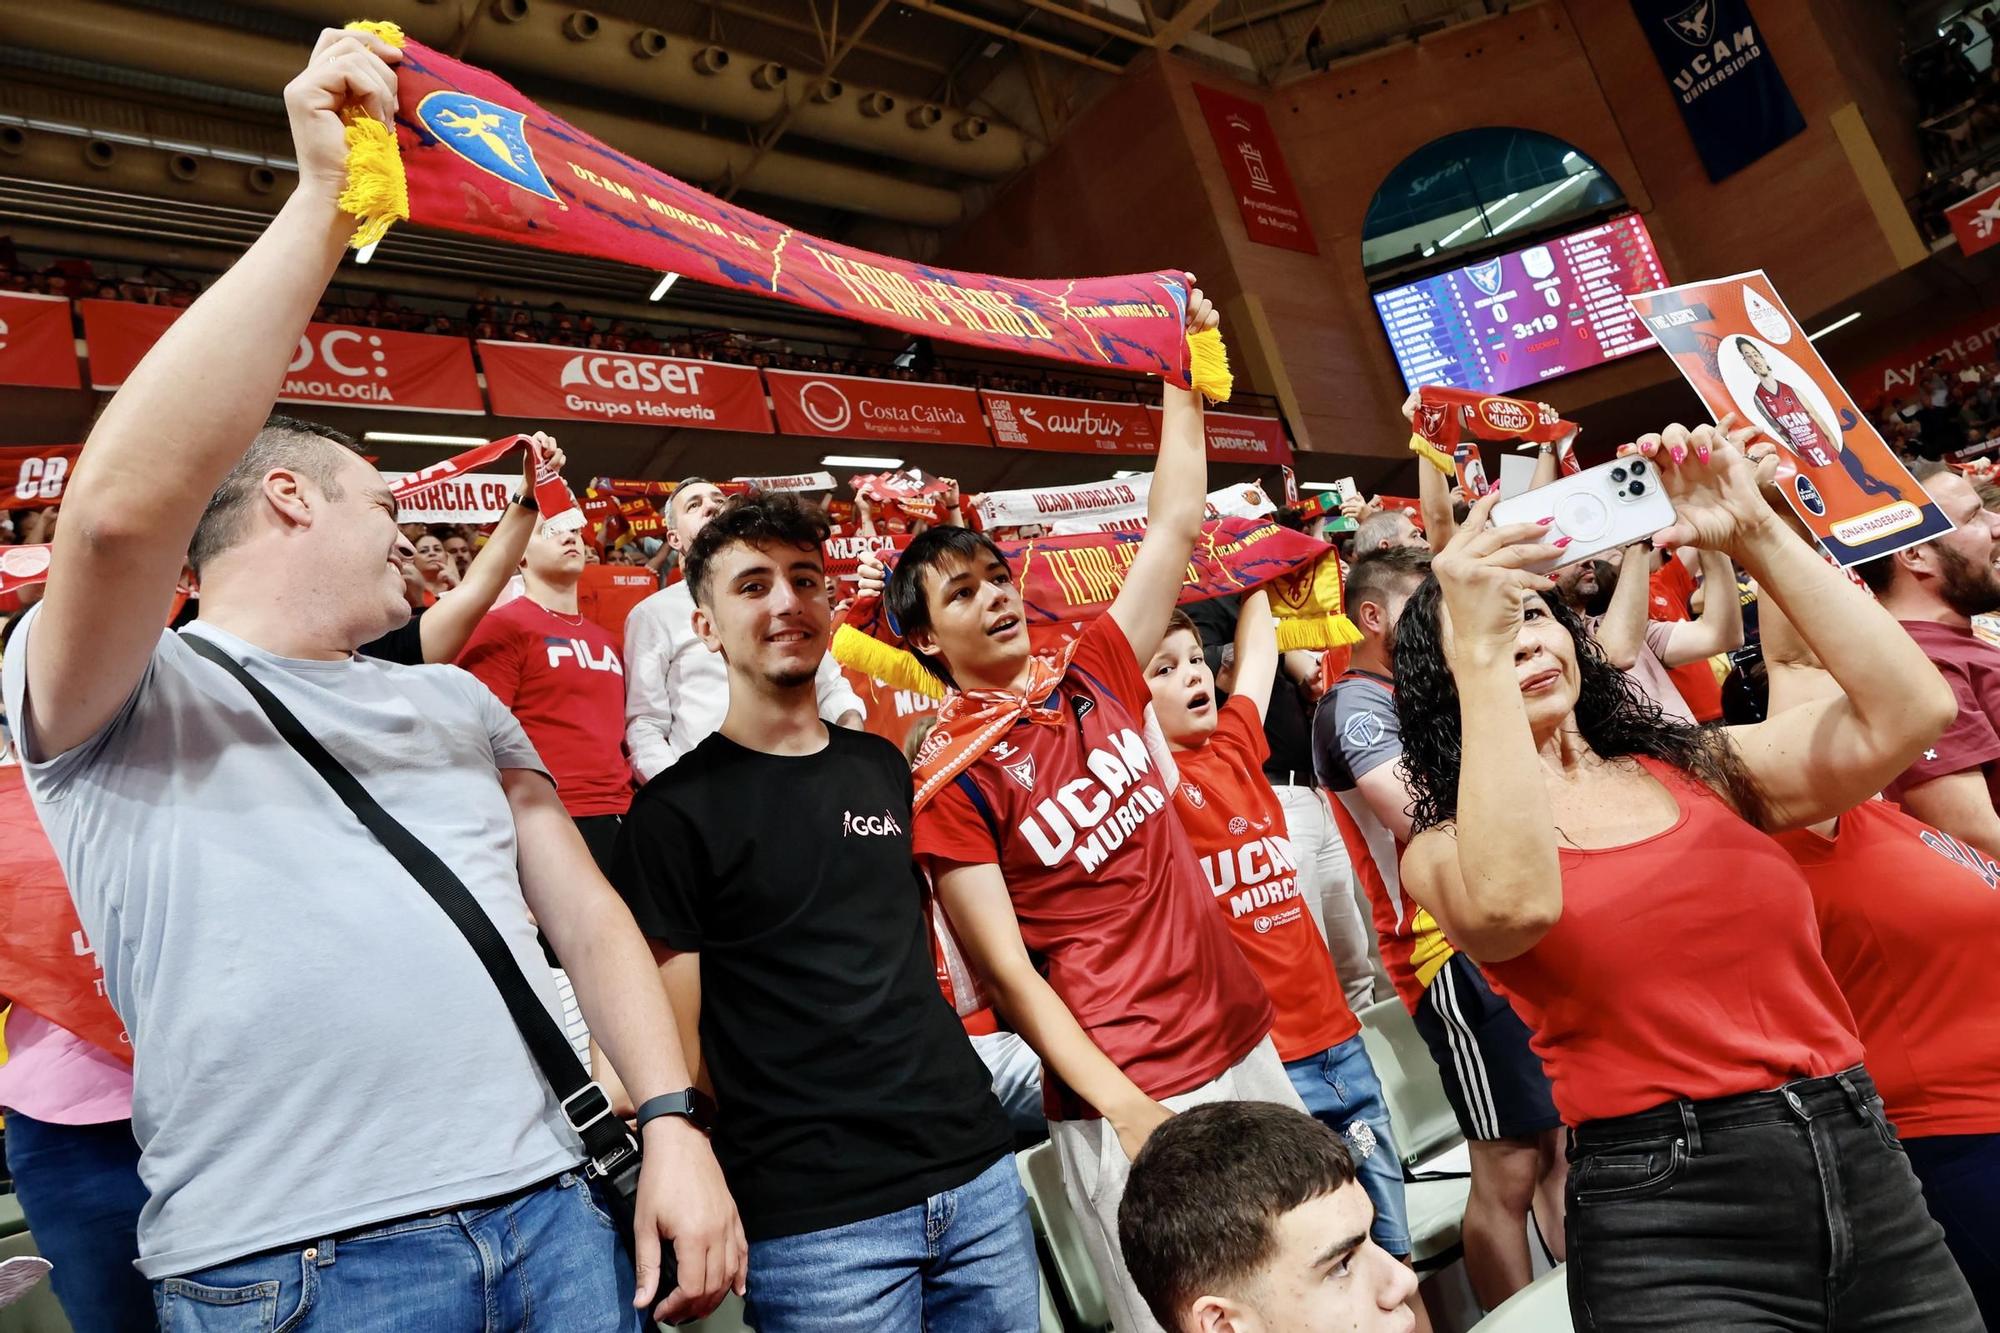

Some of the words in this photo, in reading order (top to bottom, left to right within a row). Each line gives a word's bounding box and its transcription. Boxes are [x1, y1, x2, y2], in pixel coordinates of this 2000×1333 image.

[1673, 25, 1754, 91] UCAM
[1682, 45, 1761, 104] UNIVERSIDAD
[567, 161, 637, 203] UCAM
[642, 193, 728, 239] MURCIA
[730, 230, 761, 251] CB
[1544, 287, 1560, 307] 0
[1070, 304, 1111, 319] UCAM
[1109, 303, 1154, 318] MURCIA
[1153, 303, 1170, 318] CB
[1492, 303, 1508, 323] 0
[1512, 314, 1558, 339] 3:19
[589, 357, 704, 395] caser
[281, 380, 394, 401] MOLOGÍA
[566, 394, 632, 418] Grupo
[636, 400, 716, 421] Helvetia
[859, 400, 909, 421] Costa
[911, 403, 967, 425] Cálida
[1488, 402, 1523, 417] UCAM
[1488, 412, 1528, 430] MURCIA
[1209, 436, 1268, 453] URDECON
[1808, 447, 1833, 467] 12
[15, 457, 69, 500] CB
[481, 483, 508, 511] CB
[1033, 493, 1073, 513] UCAM
[1070, 490, 1117, 510] MURCIA
[1116, 485, 1136, 504] CB
[1841, 525, 1868, 540] JONAH
[1864, 507, 1915, 532] RADEBAUGH
[826, 535, 897, 560] MURCIA
[1215, 541, 1243, 557] UCAM
[1242, 523, 1281, 547] MURCIA
[613, 575, 626, 585] THE
[547, 638, 623, 676] FILA
[1018, 728, 1154, 866] UCAM
[1074, 785, 1165, 874] MURCIA
